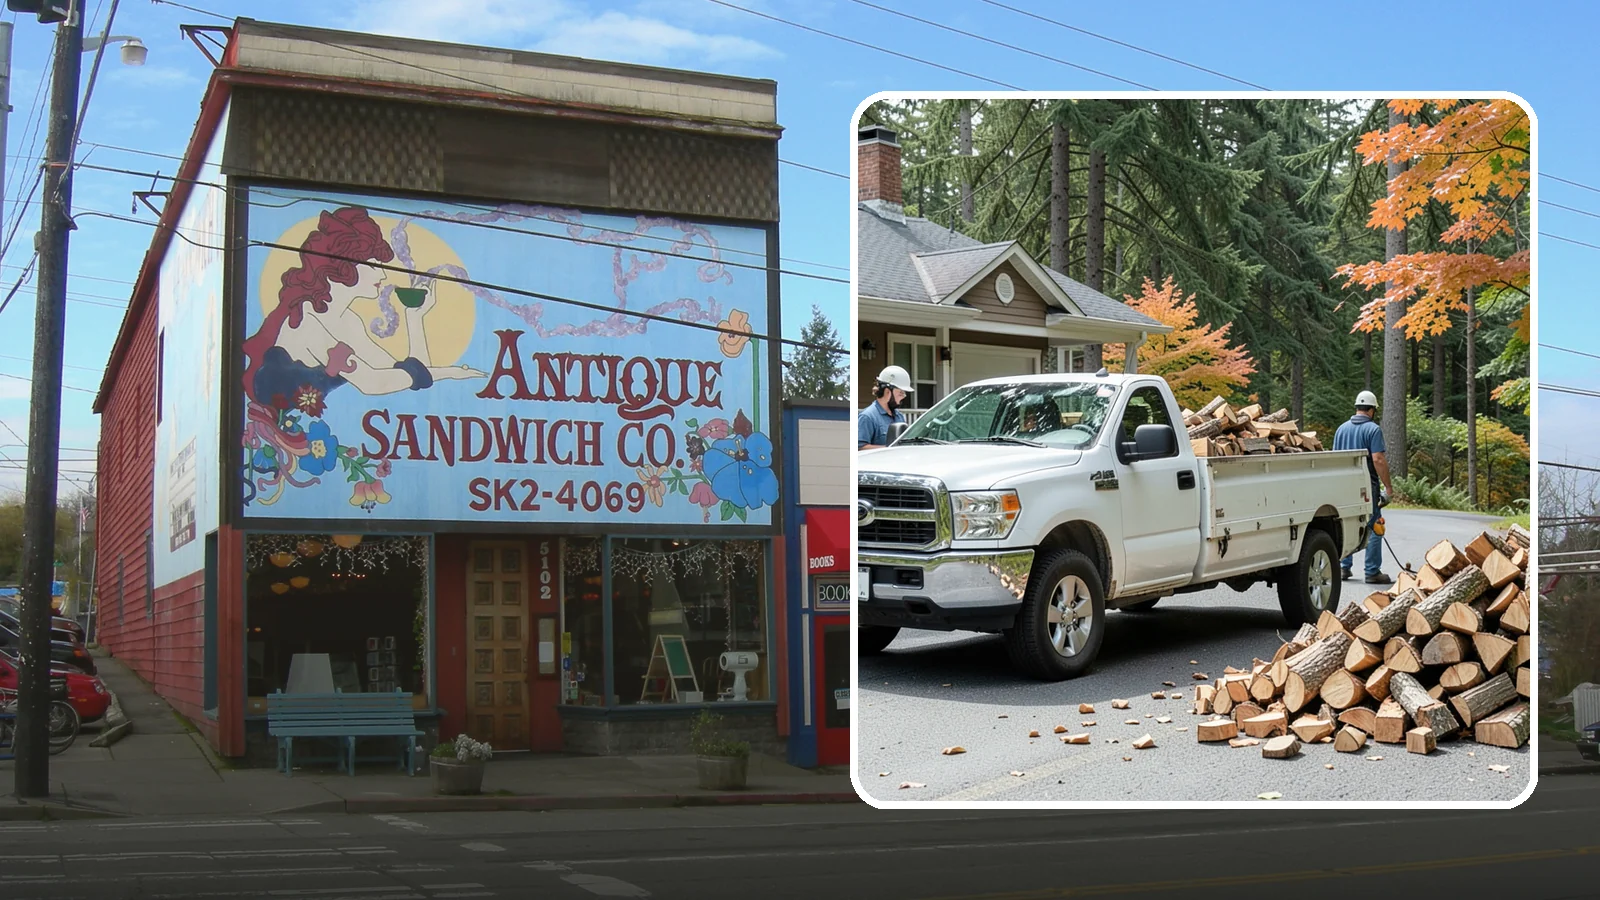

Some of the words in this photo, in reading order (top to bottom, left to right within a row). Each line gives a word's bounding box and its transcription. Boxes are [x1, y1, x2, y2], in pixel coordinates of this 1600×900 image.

[476, 329, 724, 420] ANTIQUE
[361, 408, 605, 467] SANDWICH
[616, 421, 685, 469] CO.
[468, 478, 646, 513] SK2-4069
[540, 541, 551, 600] 5102
[809, 555, 835, 569] BOOKS
